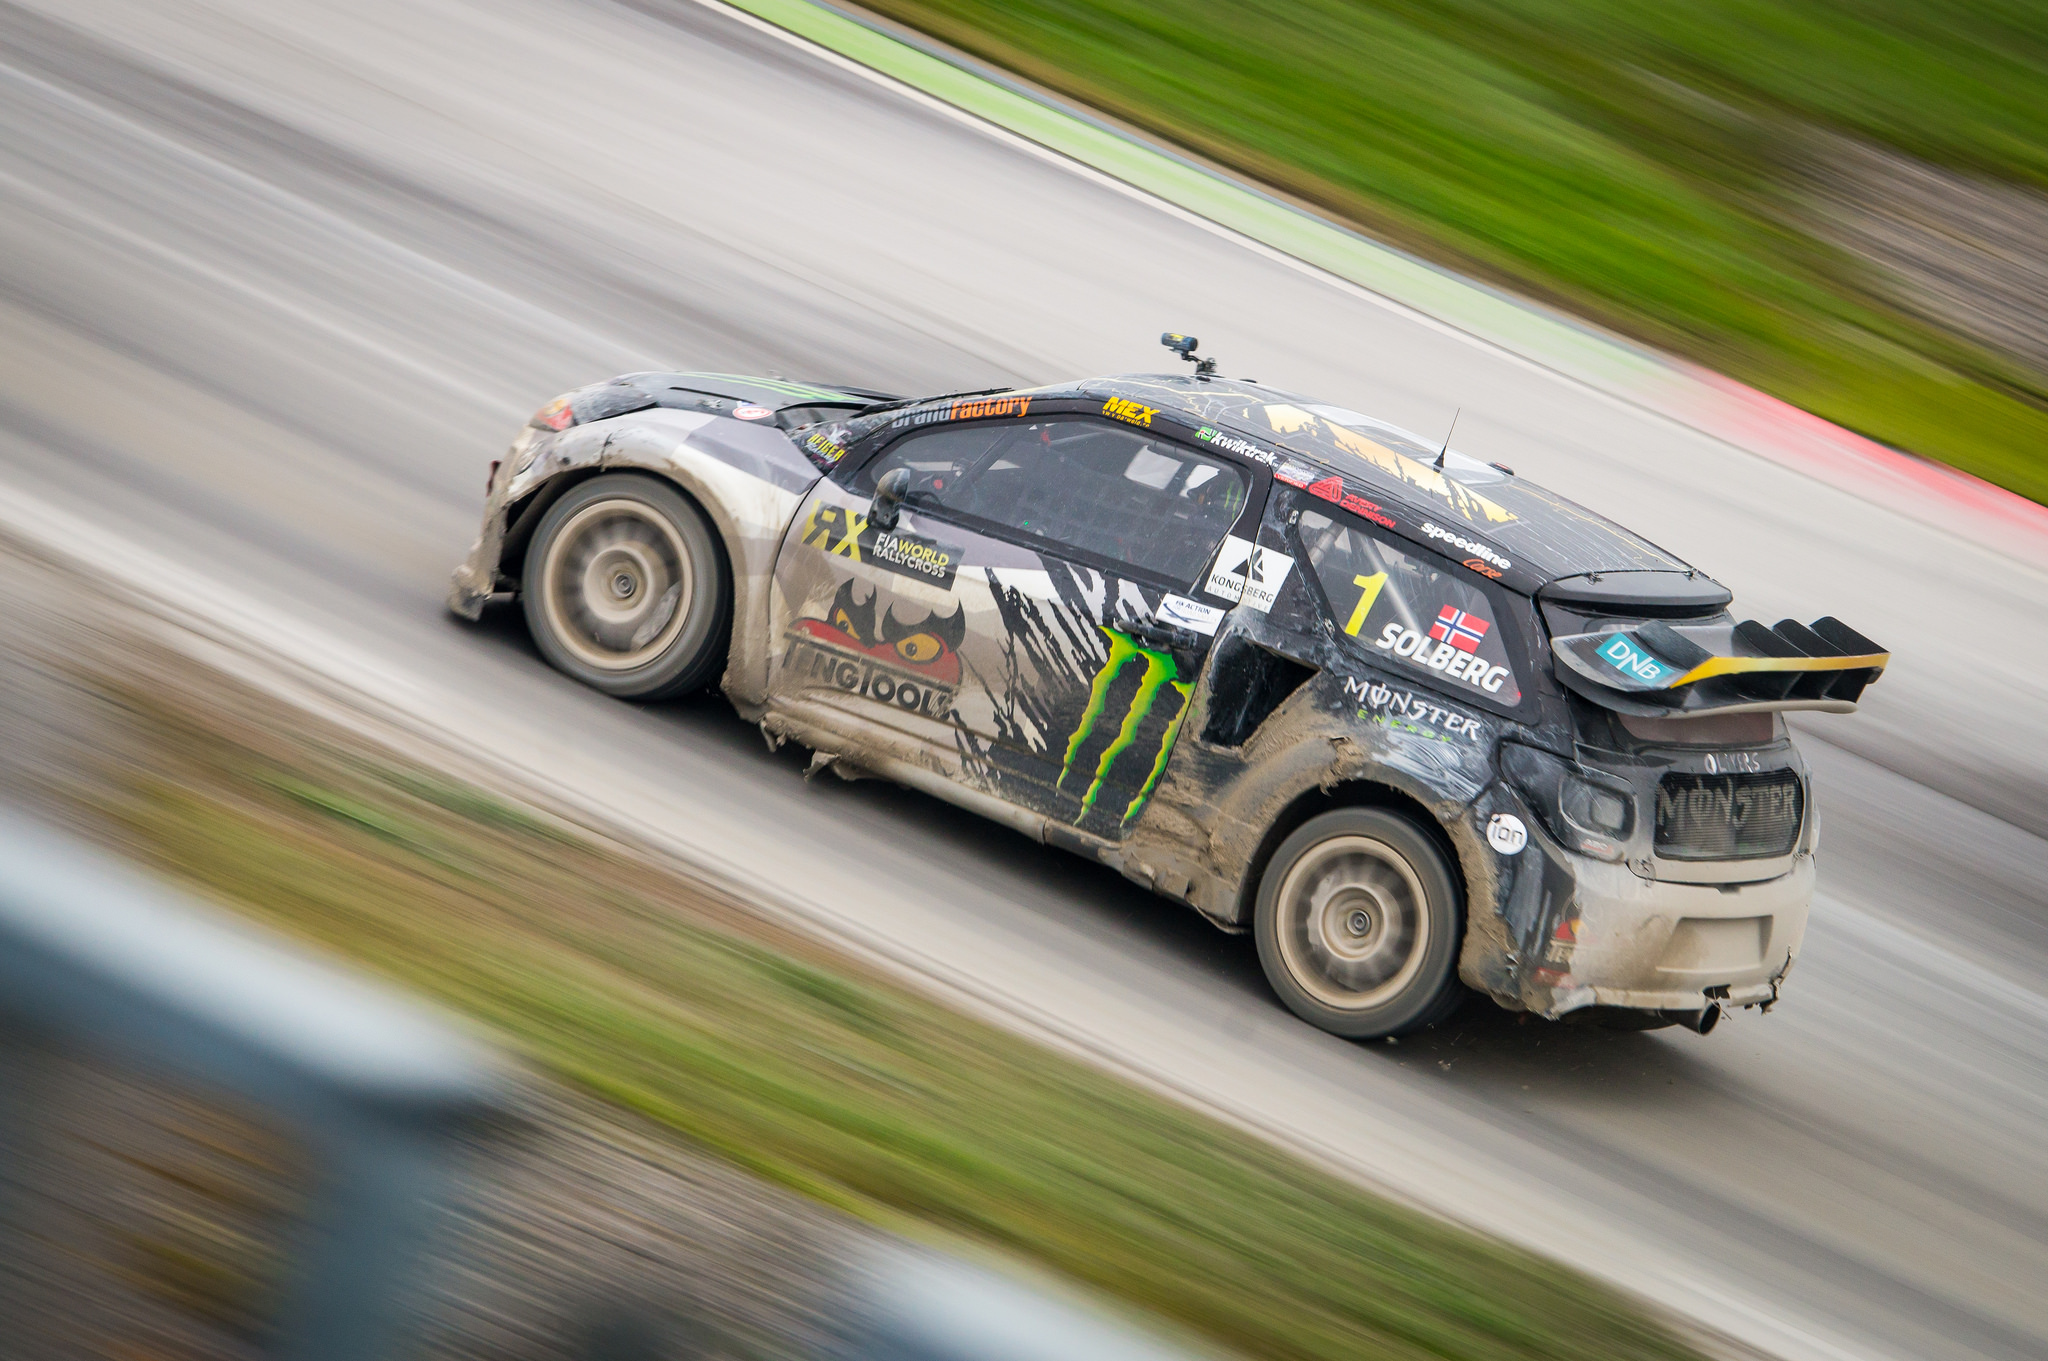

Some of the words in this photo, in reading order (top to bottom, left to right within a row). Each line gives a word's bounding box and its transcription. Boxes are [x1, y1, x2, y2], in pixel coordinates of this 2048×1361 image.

[1102, 396, 1161, 424] MEX
[1210, 431, 1277, 465] kwiktrak
[1339, 499, 1396, 529] DENNISON
[1345, 494, 1382, 512] AVERY
[872, 545, 947, 579] RALLYCROSS
[1420, 522, 1512, 570] speedline
[1211, 573, 1275, 603] KONGSBERG
[1344, 570, 1389, 638] 1
[1375, 622, 1510, 694] SOLBERG
[1606, 640, 1661, 680] DNB
[1357, 708, 1453, 742] ENERGY
